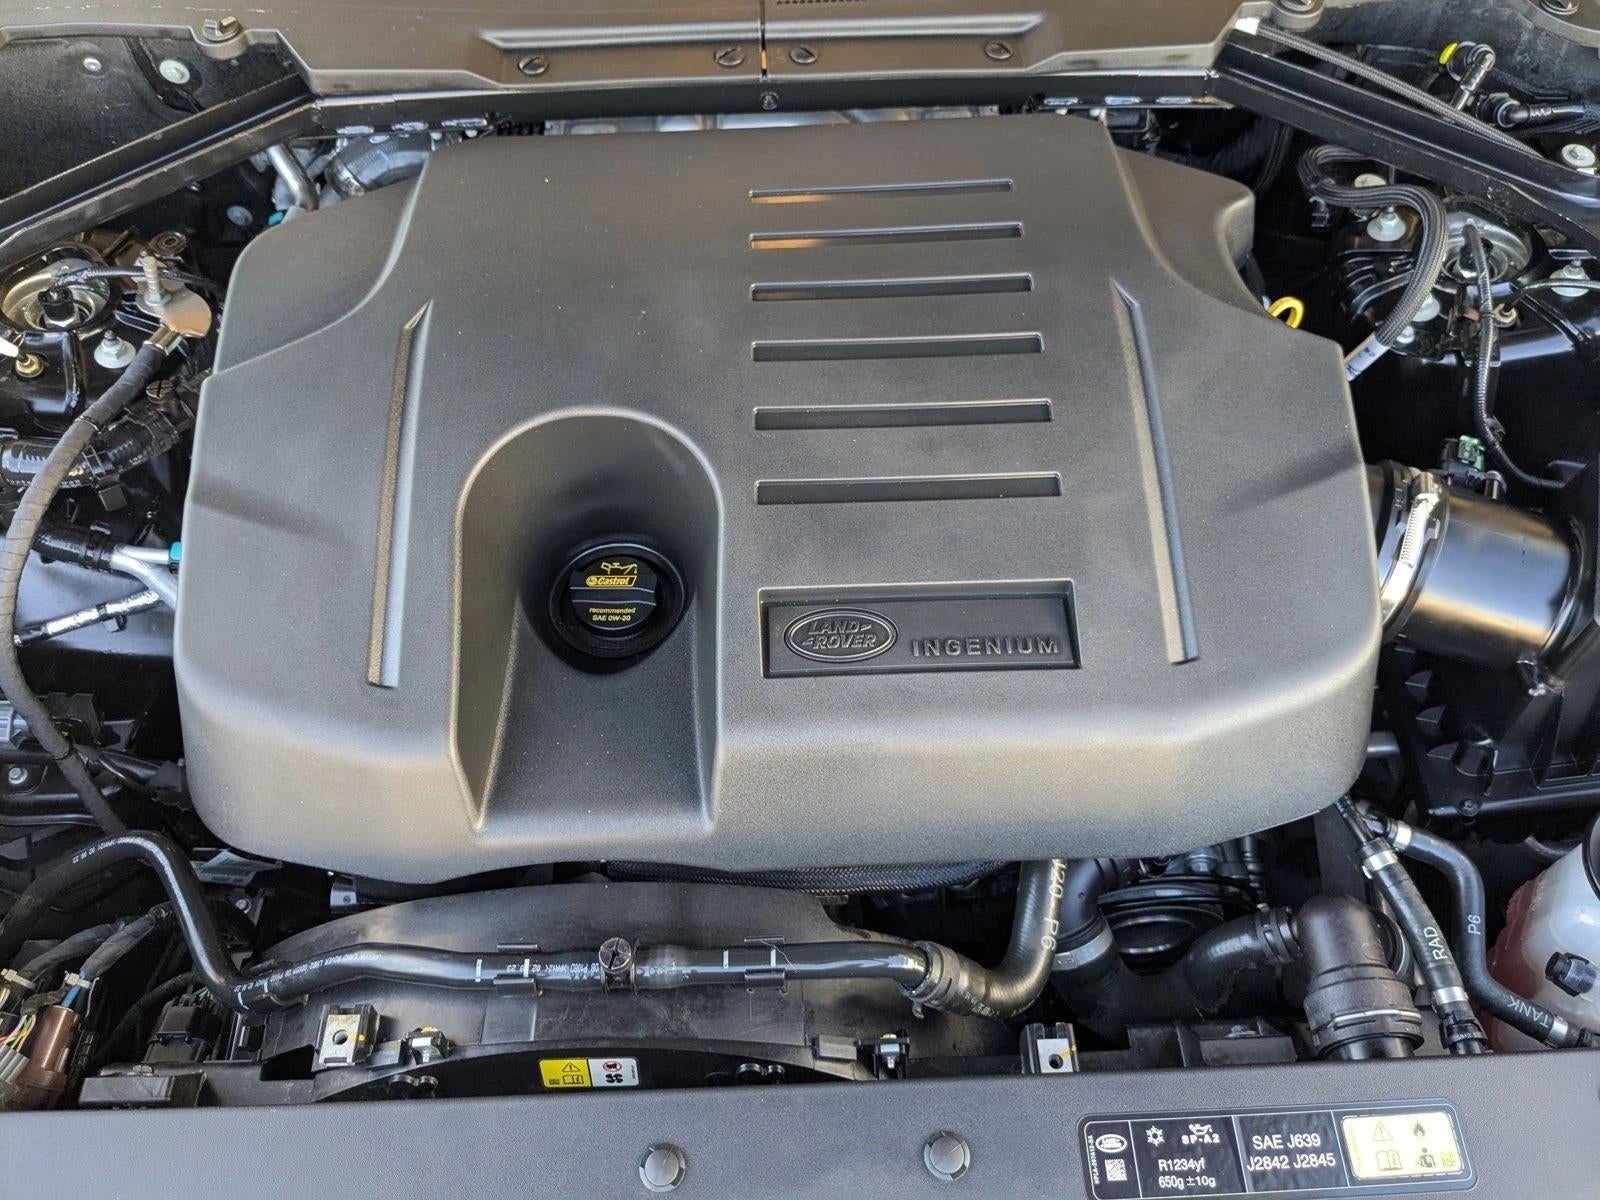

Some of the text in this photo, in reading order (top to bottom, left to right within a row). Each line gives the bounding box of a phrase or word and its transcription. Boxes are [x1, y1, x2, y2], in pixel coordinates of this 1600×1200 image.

[597, 577, 630, 585] Castrol
[911, 637, 1060, 657] INGENIUM
[1041, 916, 1060, 951] P6
[1467, 914, 1481, 935] P6
[1423, 926, 1448, 960] RAD
[1507, 995, 1549, 1028] TANK
[1181, 1133, 1220, 1144] SP-A2
[1252, 1133, 1321, 1150] SAE J639
[1158, 1157, 1205, 1173] R1234yf
[1246, 1152, 1336, 1171] J2842 J2845
[1158, 1175, 1185, 1190] 650g
